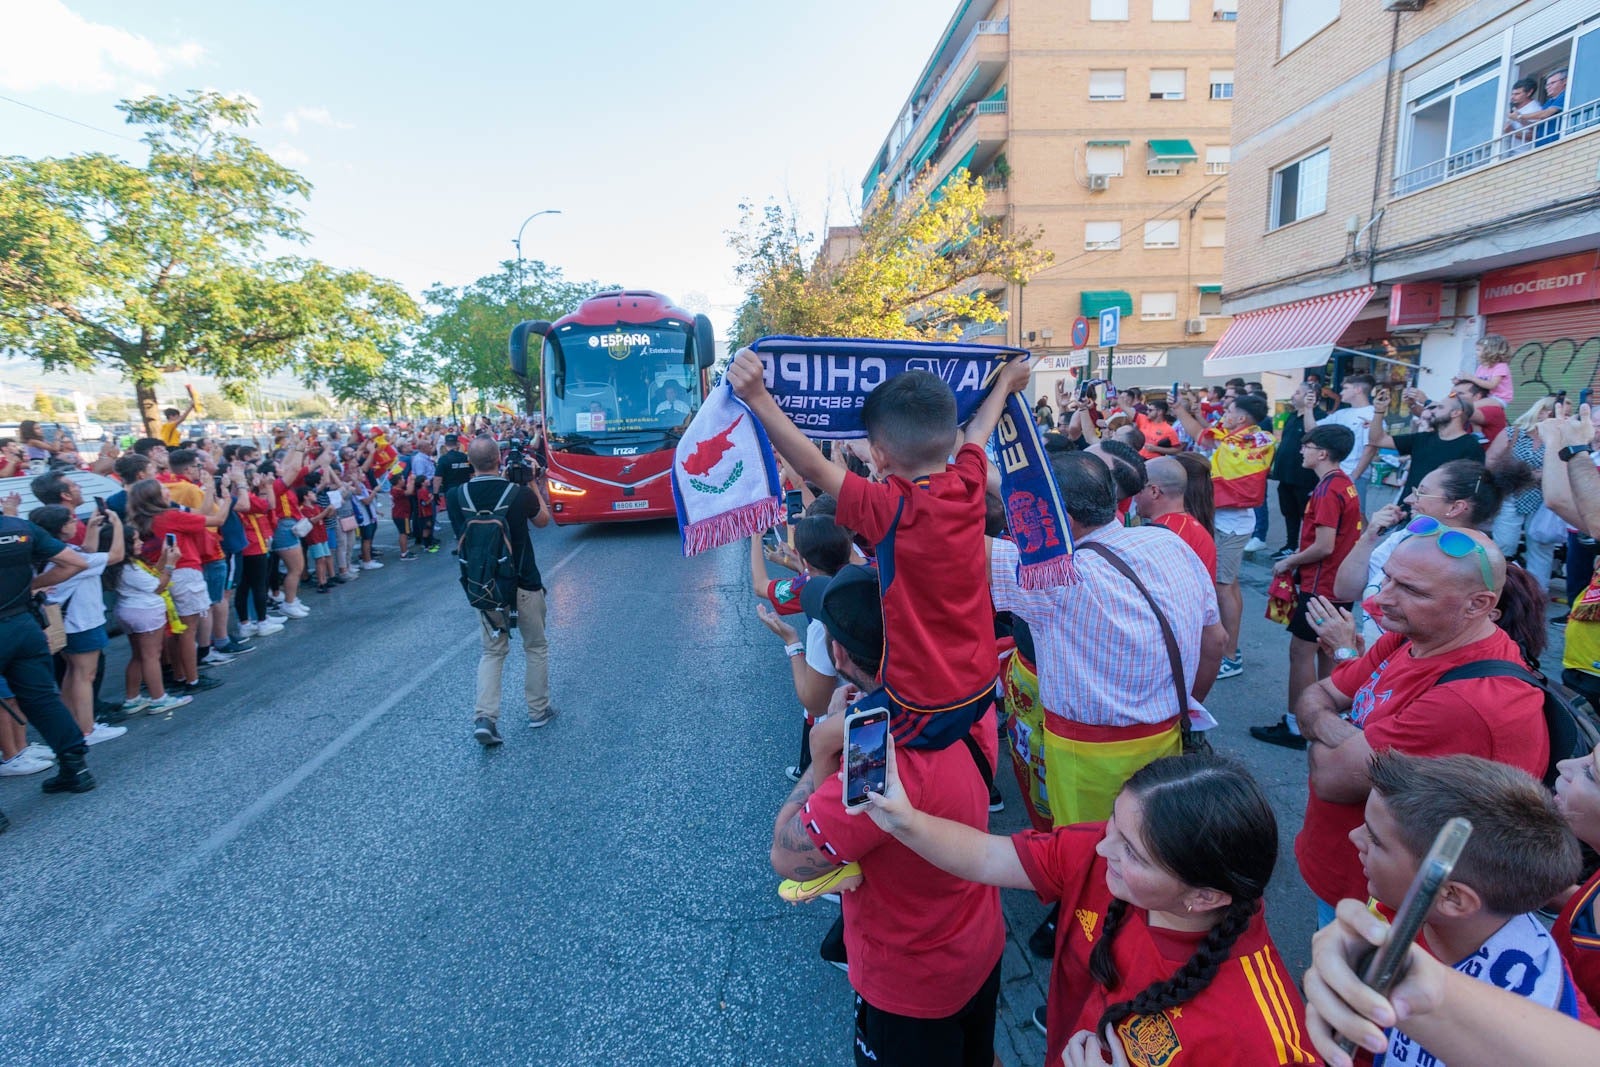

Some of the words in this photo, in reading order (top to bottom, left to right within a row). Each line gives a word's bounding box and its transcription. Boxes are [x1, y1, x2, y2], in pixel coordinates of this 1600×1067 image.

[1485, 272, 1586, 299] INMOCREDIT
[600, 333, 650, 347] ESPAÑA
[1102, 313, 1114, 342] P
